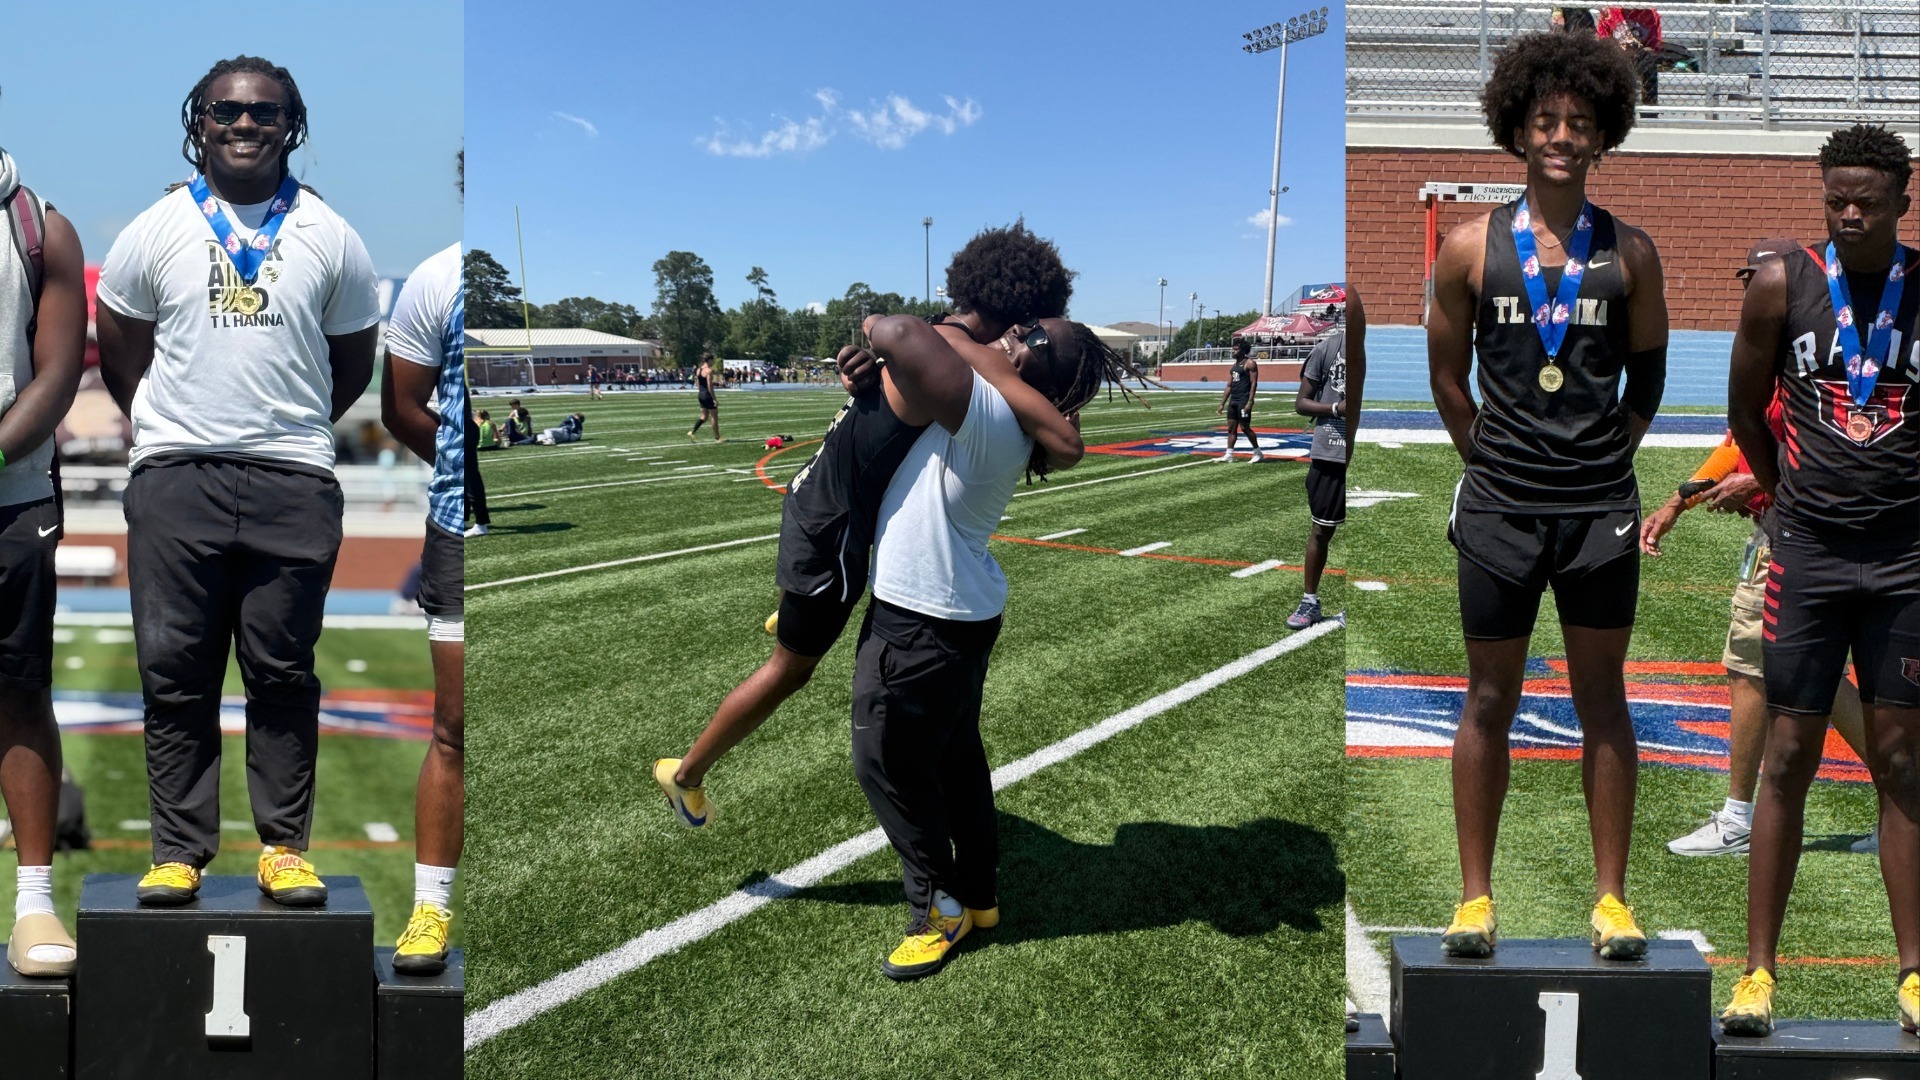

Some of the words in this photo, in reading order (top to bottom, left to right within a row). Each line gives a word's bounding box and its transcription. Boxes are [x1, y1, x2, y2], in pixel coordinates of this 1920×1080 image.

[211, 315, 219, 328] T
[223, 315, 230, 328] L
[233, 313, 285, 327] HANNA
[1493, 296, 1525, 324] TL
[274, 856, 305, 871] NIKE
[205, 935, 251, 1036] 1
[1535, 992, 1583, 1080] 1
